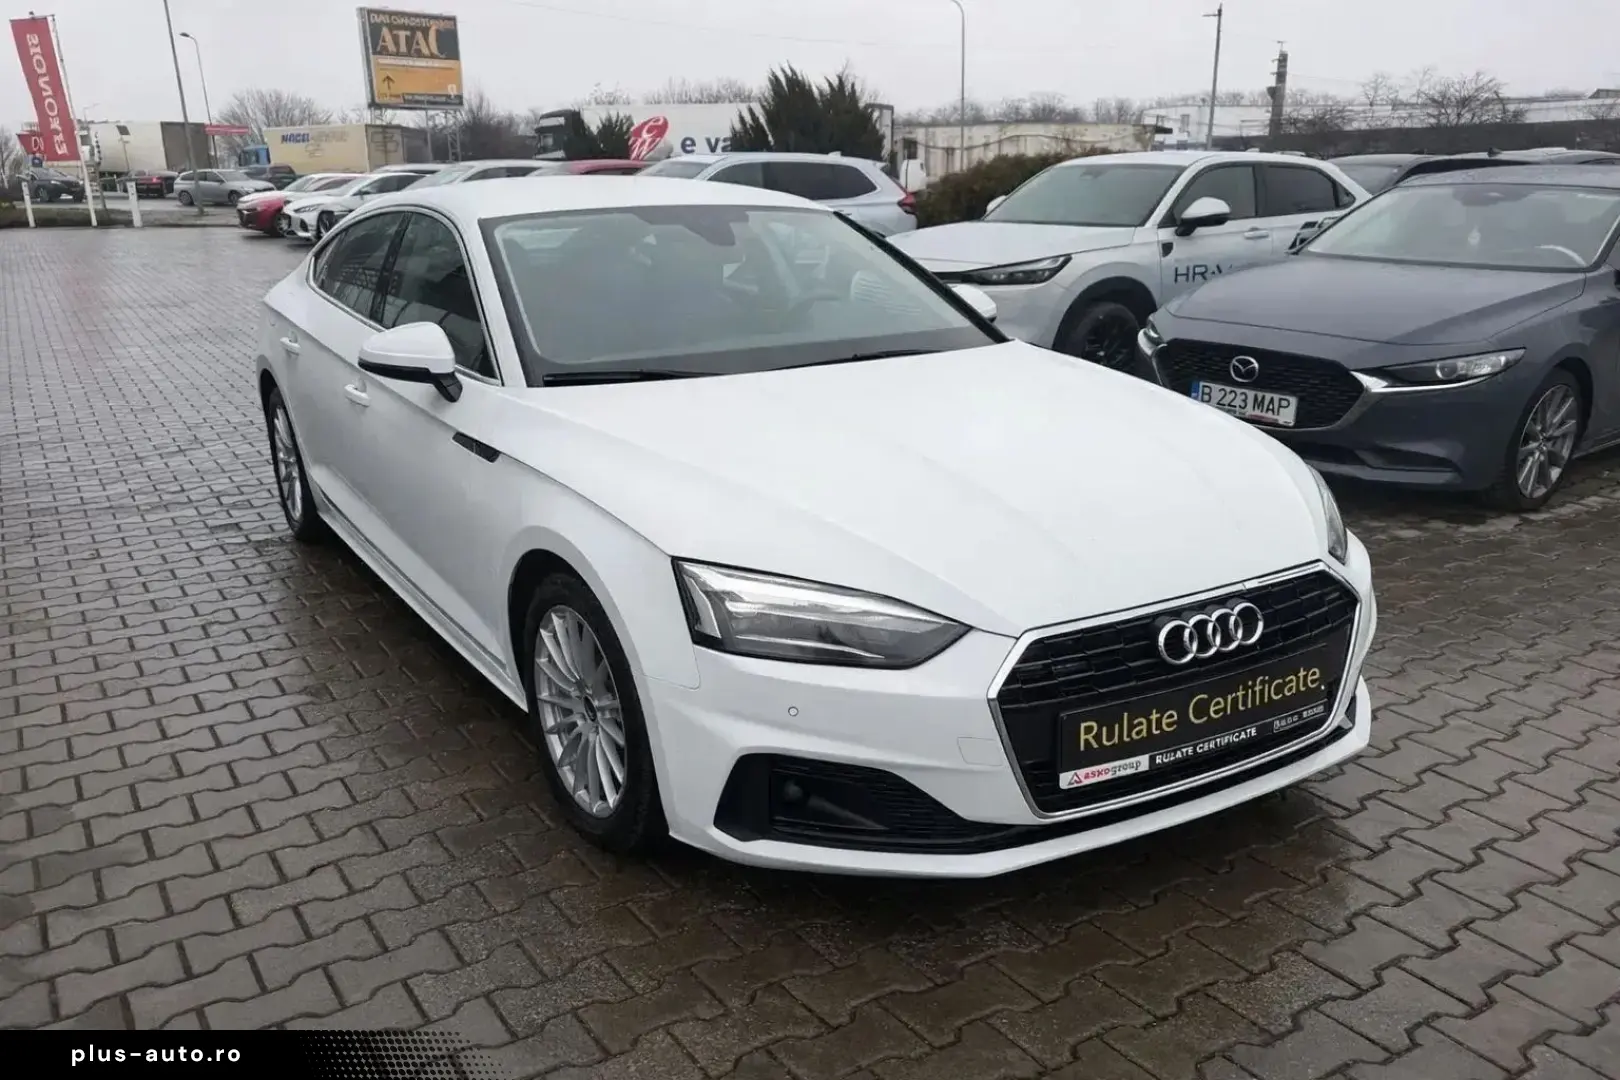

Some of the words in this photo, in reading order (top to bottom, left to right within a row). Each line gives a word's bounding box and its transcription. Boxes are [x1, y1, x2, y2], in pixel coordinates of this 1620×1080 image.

[1201, 384, 1212, 403] B
[1216, 388, 1248, 410] 223
[1252, 393, 1291, 416] MAP
[1080, 709, 1178, 752] Rulate
[1155, 746, 1194, 765] RULATE
[1196, 727, 1258, 754] CERTIFICATE
